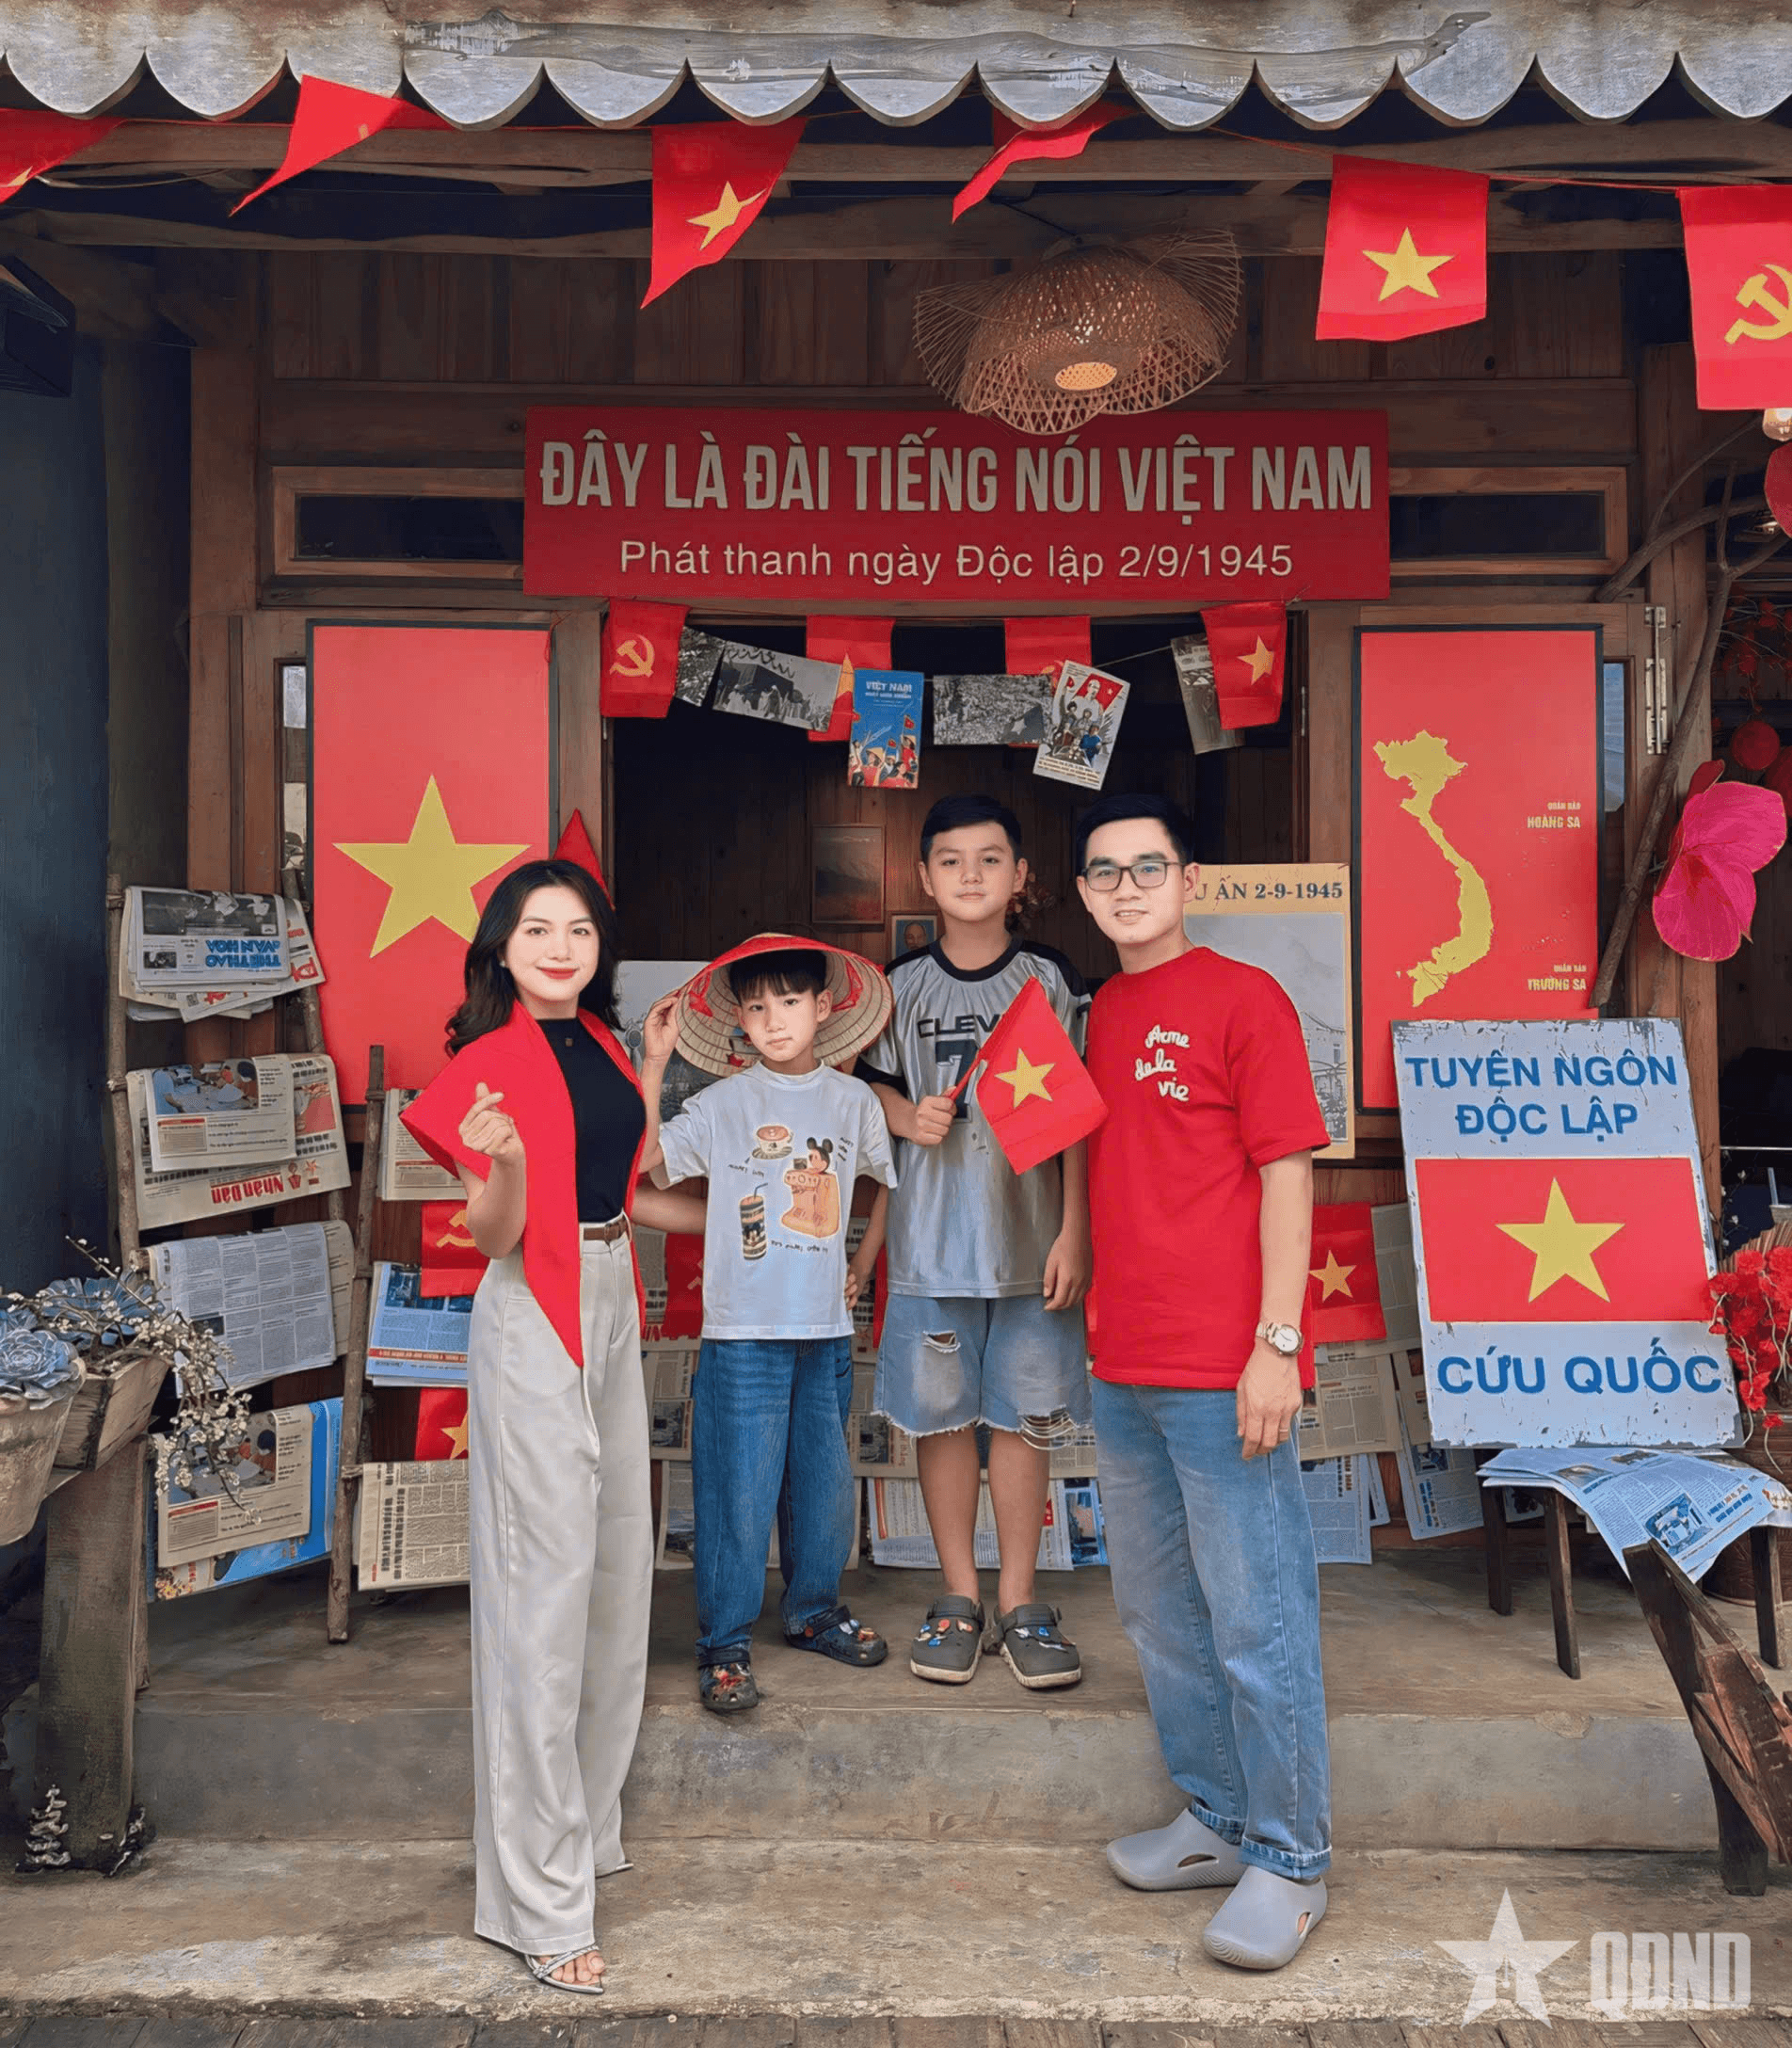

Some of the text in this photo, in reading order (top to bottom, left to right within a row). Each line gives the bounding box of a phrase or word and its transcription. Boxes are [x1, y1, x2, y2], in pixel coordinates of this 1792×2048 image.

[539, 426, 1371, 526] ĐÂY LÀ ĐÀI TIẾNG NÓI VIỆT NAM
[621, 540, 1292, 585] Phát thanh ngày Độc lập 2/9/1945
[1566, 815, 1581, 829] SA
[1254, 881, 1344, 900] 2-9-1945
[1572, 978, 1587, 991] SA
[1405, 1048, 1677, 1088] TUYÊN NGÔN
[1158, 1077, 1190, 1102] vie
[1455, 1096, 1639, 1143] ĐỘC LẬP
[1437, 1337, 1721, 1395] CỨU QUỐC
